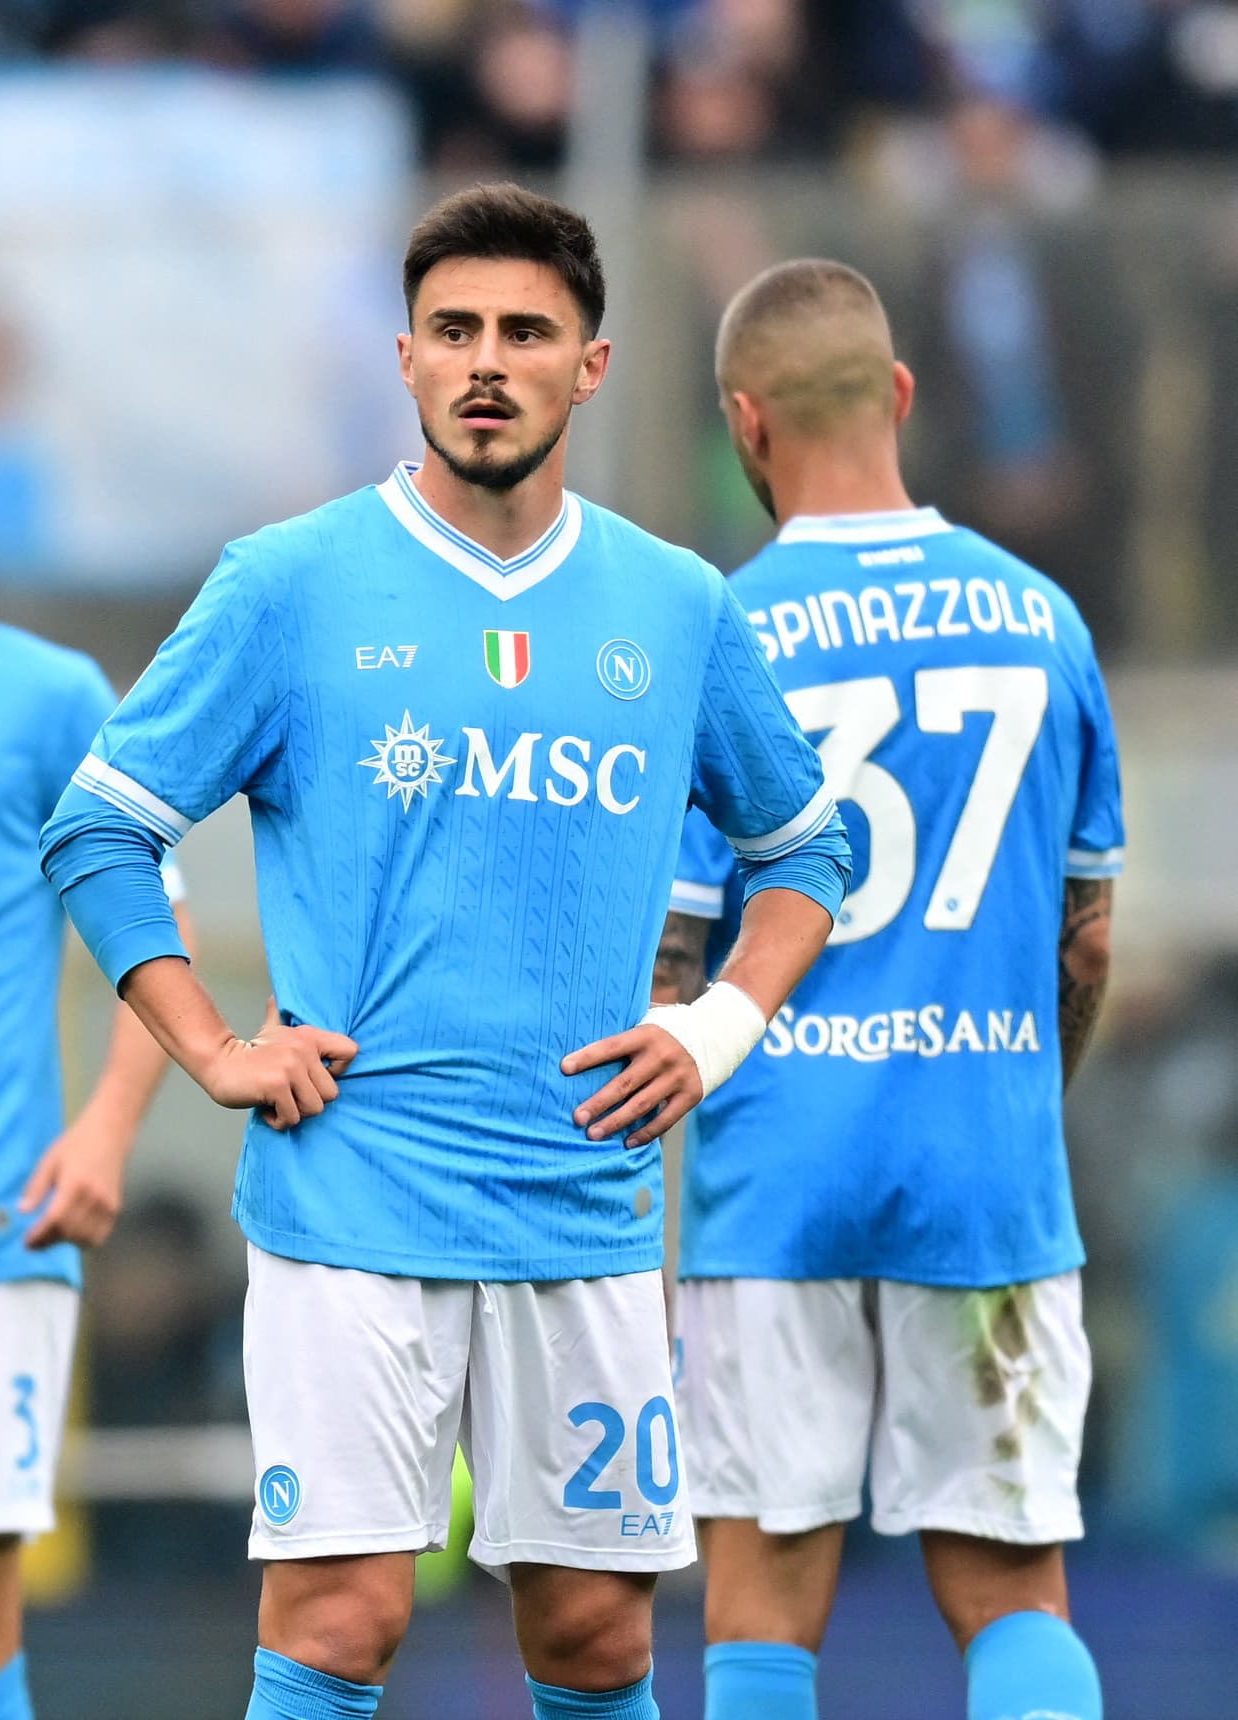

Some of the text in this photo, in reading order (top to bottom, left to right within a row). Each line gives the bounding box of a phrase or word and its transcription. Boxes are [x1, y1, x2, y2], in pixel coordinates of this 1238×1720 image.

[355, 644, 418, 670] EA7
[748, 578, 1055, 662] SPINAZZOLA
[612, 655, 635, 684] N
[455, 727, 646, 815] MSC
[784, 666, 1048, 946] 37
[11, 1374, 39, 1470] 3
[563, 1395, 679, 1510] 20
[272, 1480, 291, 1508] N
[620, 1512, 674, 1537] EA7
